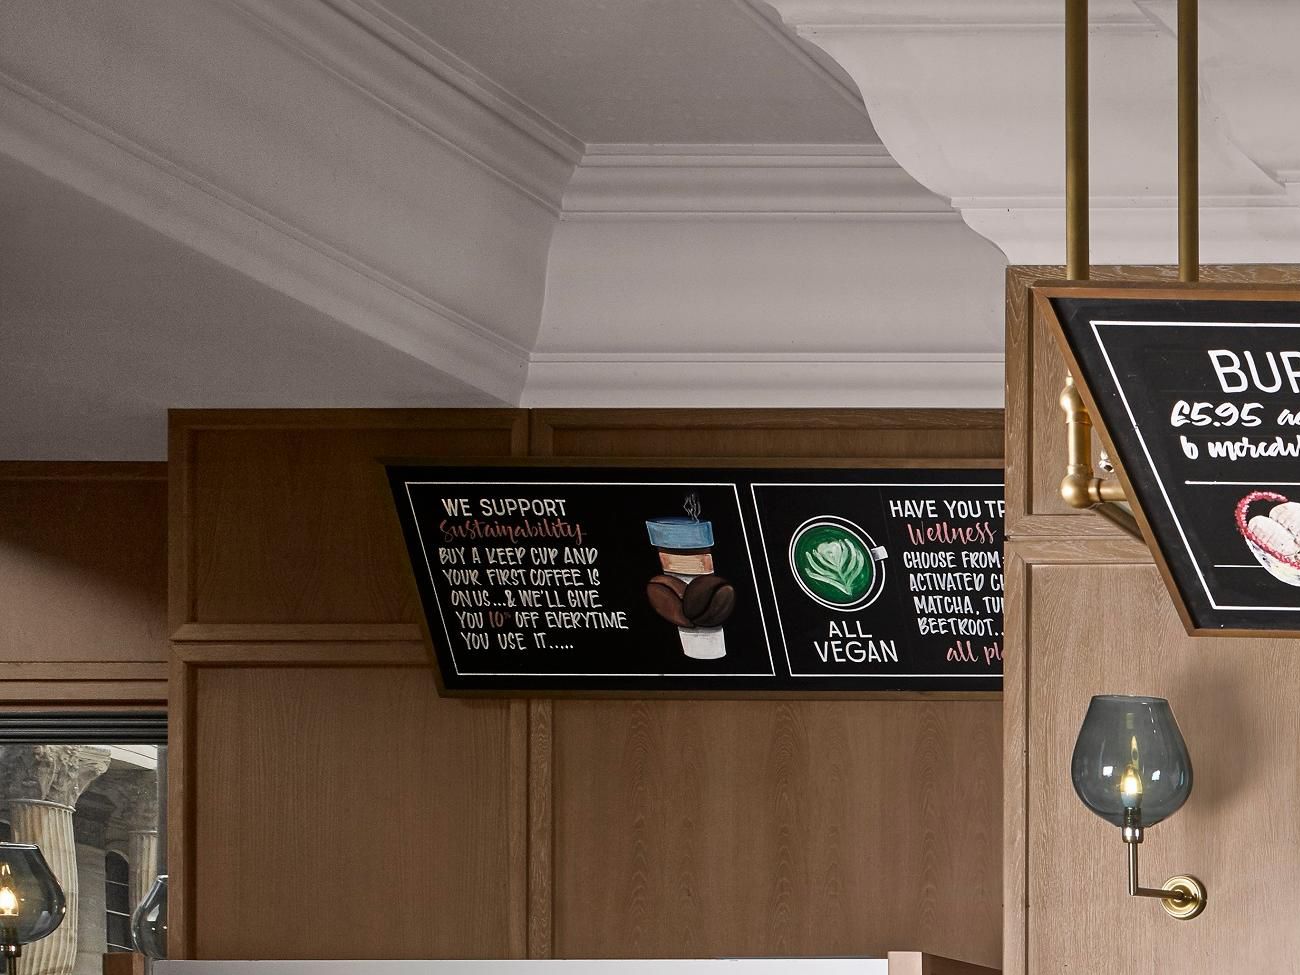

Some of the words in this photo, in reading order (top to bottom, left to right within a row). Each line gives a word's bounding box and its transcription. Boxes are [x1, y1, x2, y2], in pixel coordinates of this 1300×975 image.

[1171, 400, 1264, 427] £5.95
[441, 499, 472, 516] WE
[480, 499, 565, 516] SUPPORT
[890, 500, 938, 518] HAVE
[944, 500, 981, 518] YOU
[440, 518, 585, 545] Sustainability
[908, 522, 996, 545] Wellness
[439, 547, 465, 564] BUY
[472, 547, 481, 563] A
[531, 547, 558, 565] CUP
[564, 547, 598, 564] AND
[904, 552, 956, 568] CHOOSE
[442, 569, 482, 585] YOUR
[487, 569, 526, 585] FIRST
[530, 569, 584, 586] COFFEE
[587, 569, 600, 585] IS
[910, 573, 984, 591] ACTIVATED
[518, 590, 566, 607] WE'LL
[568, 590, 602, 608] GIVE
[456, 612, 483, 628] YOU
[515, 612, 539, 628] OFF
[830, 621, 872, 637] ALL
[461, 632, 488, 649] YOU
[498, 632, 526, 650] USE
[814, 640, 898, 662] VEGAN
[947, 641, 978, 662] all
